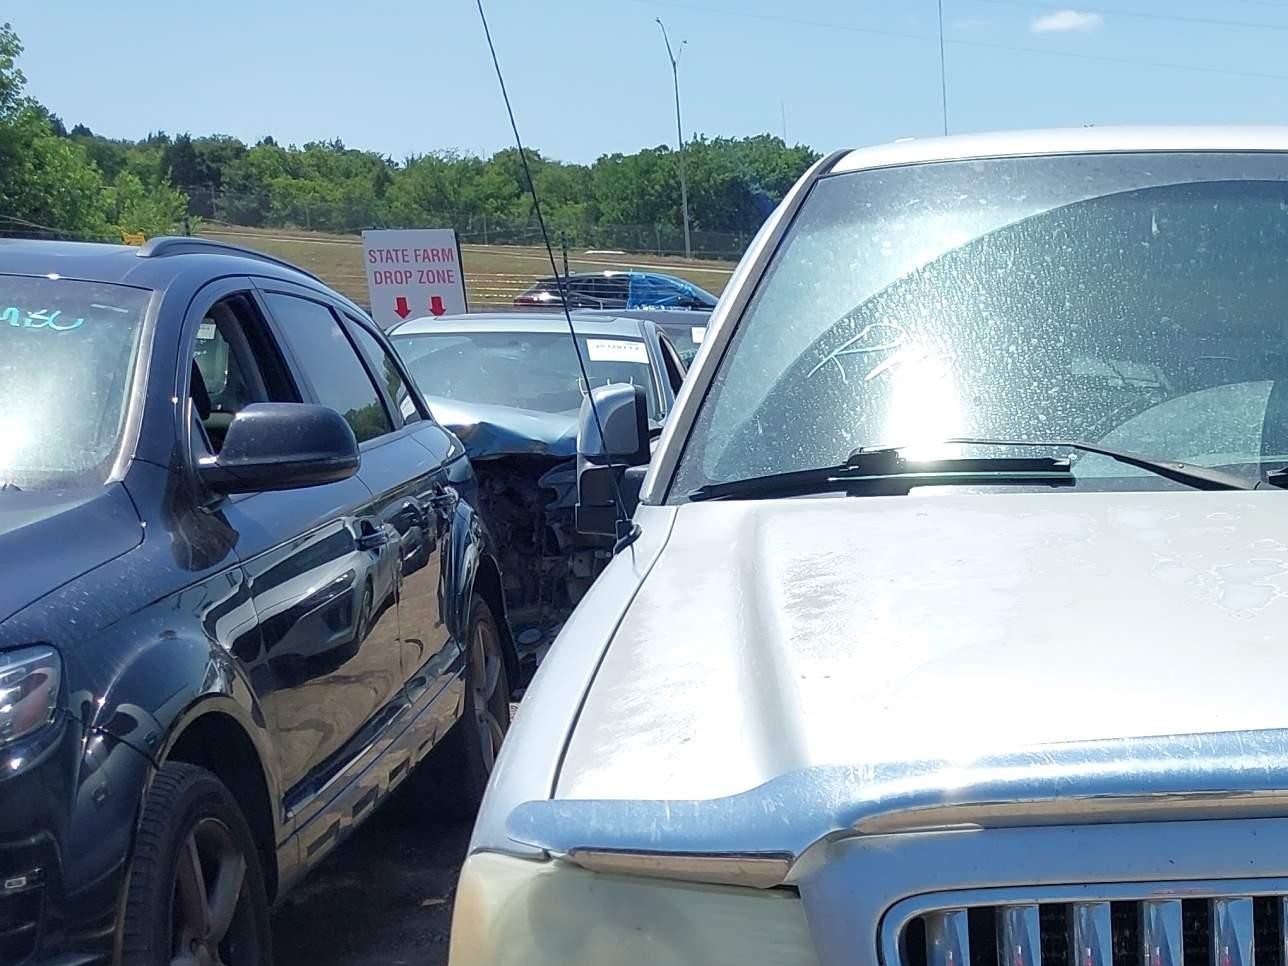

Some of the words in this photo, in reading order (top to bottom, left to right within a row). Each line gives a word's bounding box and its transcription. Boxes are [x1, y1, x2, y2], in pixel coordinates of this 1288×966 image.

[368, 249, 410, 263] STATE
[414, 248, 454, 262] FARM
[373, 270, 413, 285] DROP
[417, 270, 455, 284] ZONE
